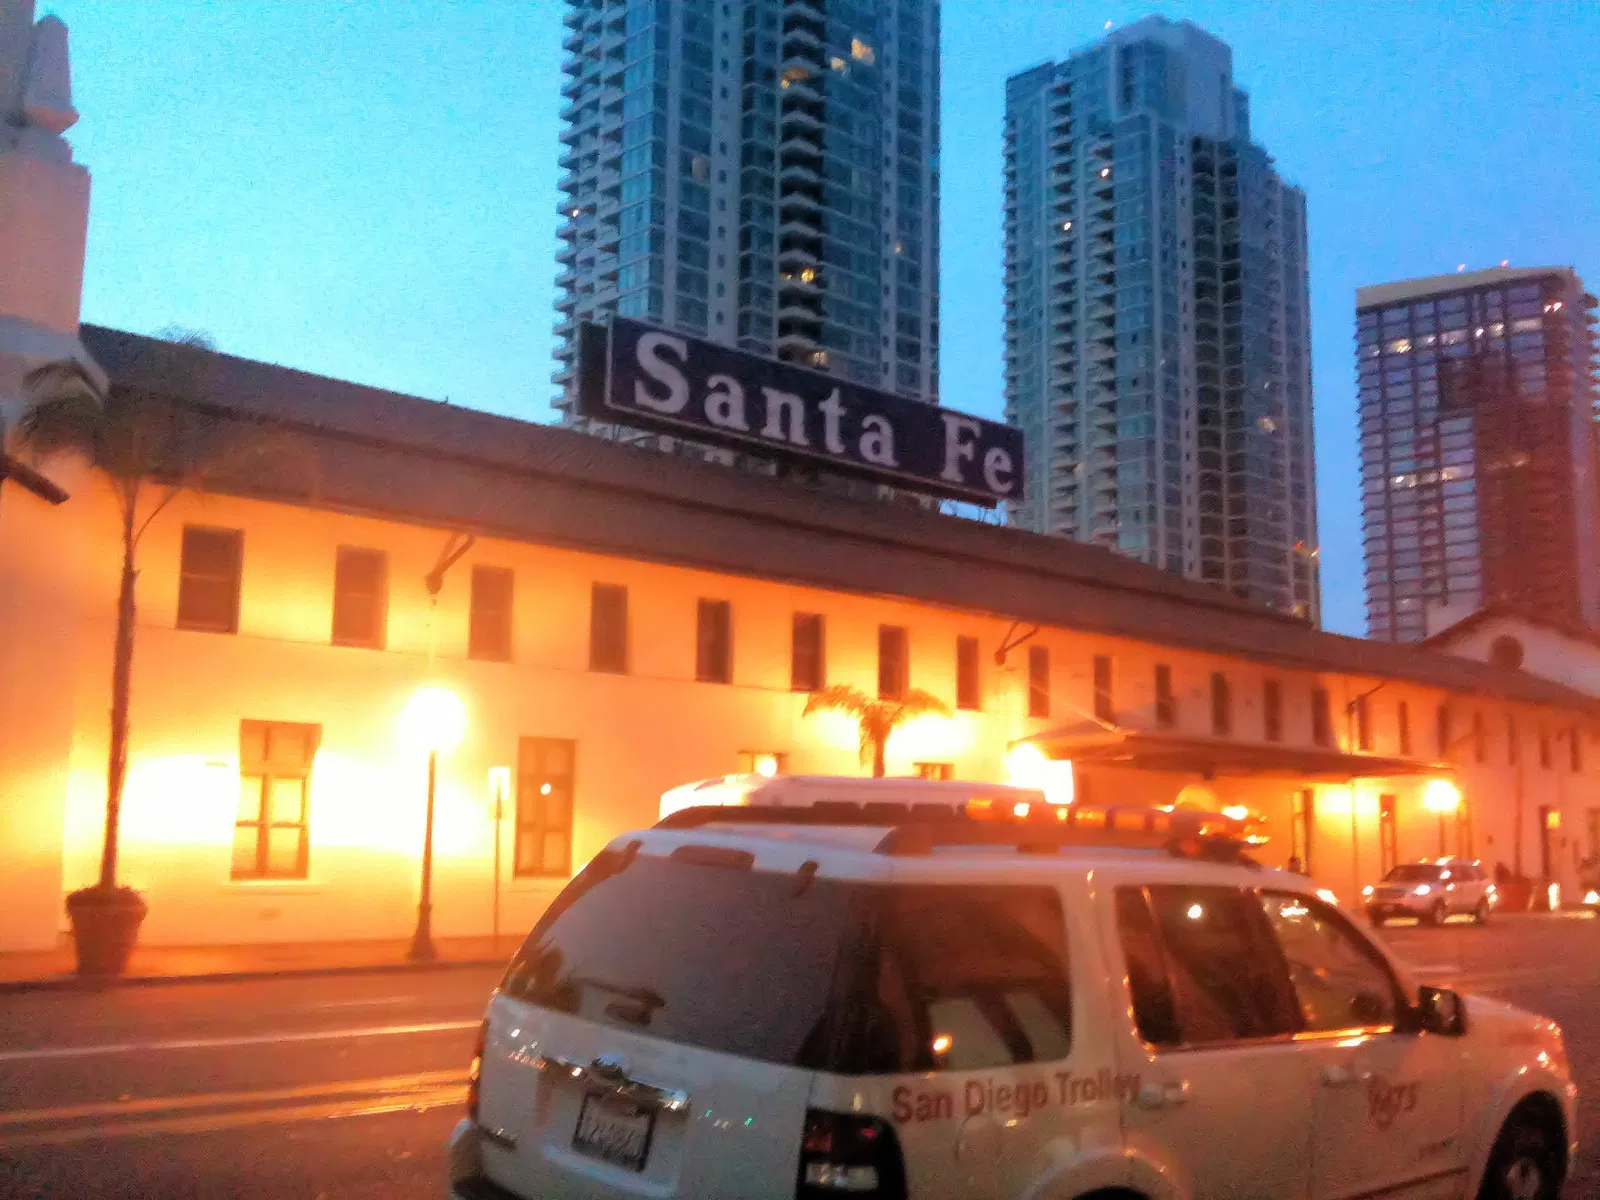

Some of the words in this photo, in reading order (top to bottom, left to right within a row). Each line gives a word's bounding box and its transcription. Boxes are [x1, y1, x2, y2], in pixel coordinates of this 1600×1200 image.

[634, 332, 899, 467] Santa
[940, 413, 1014, 494] Fe
[891, 1085, 953, 1124] San
[964, 1077, 1050, 1117] Diego
